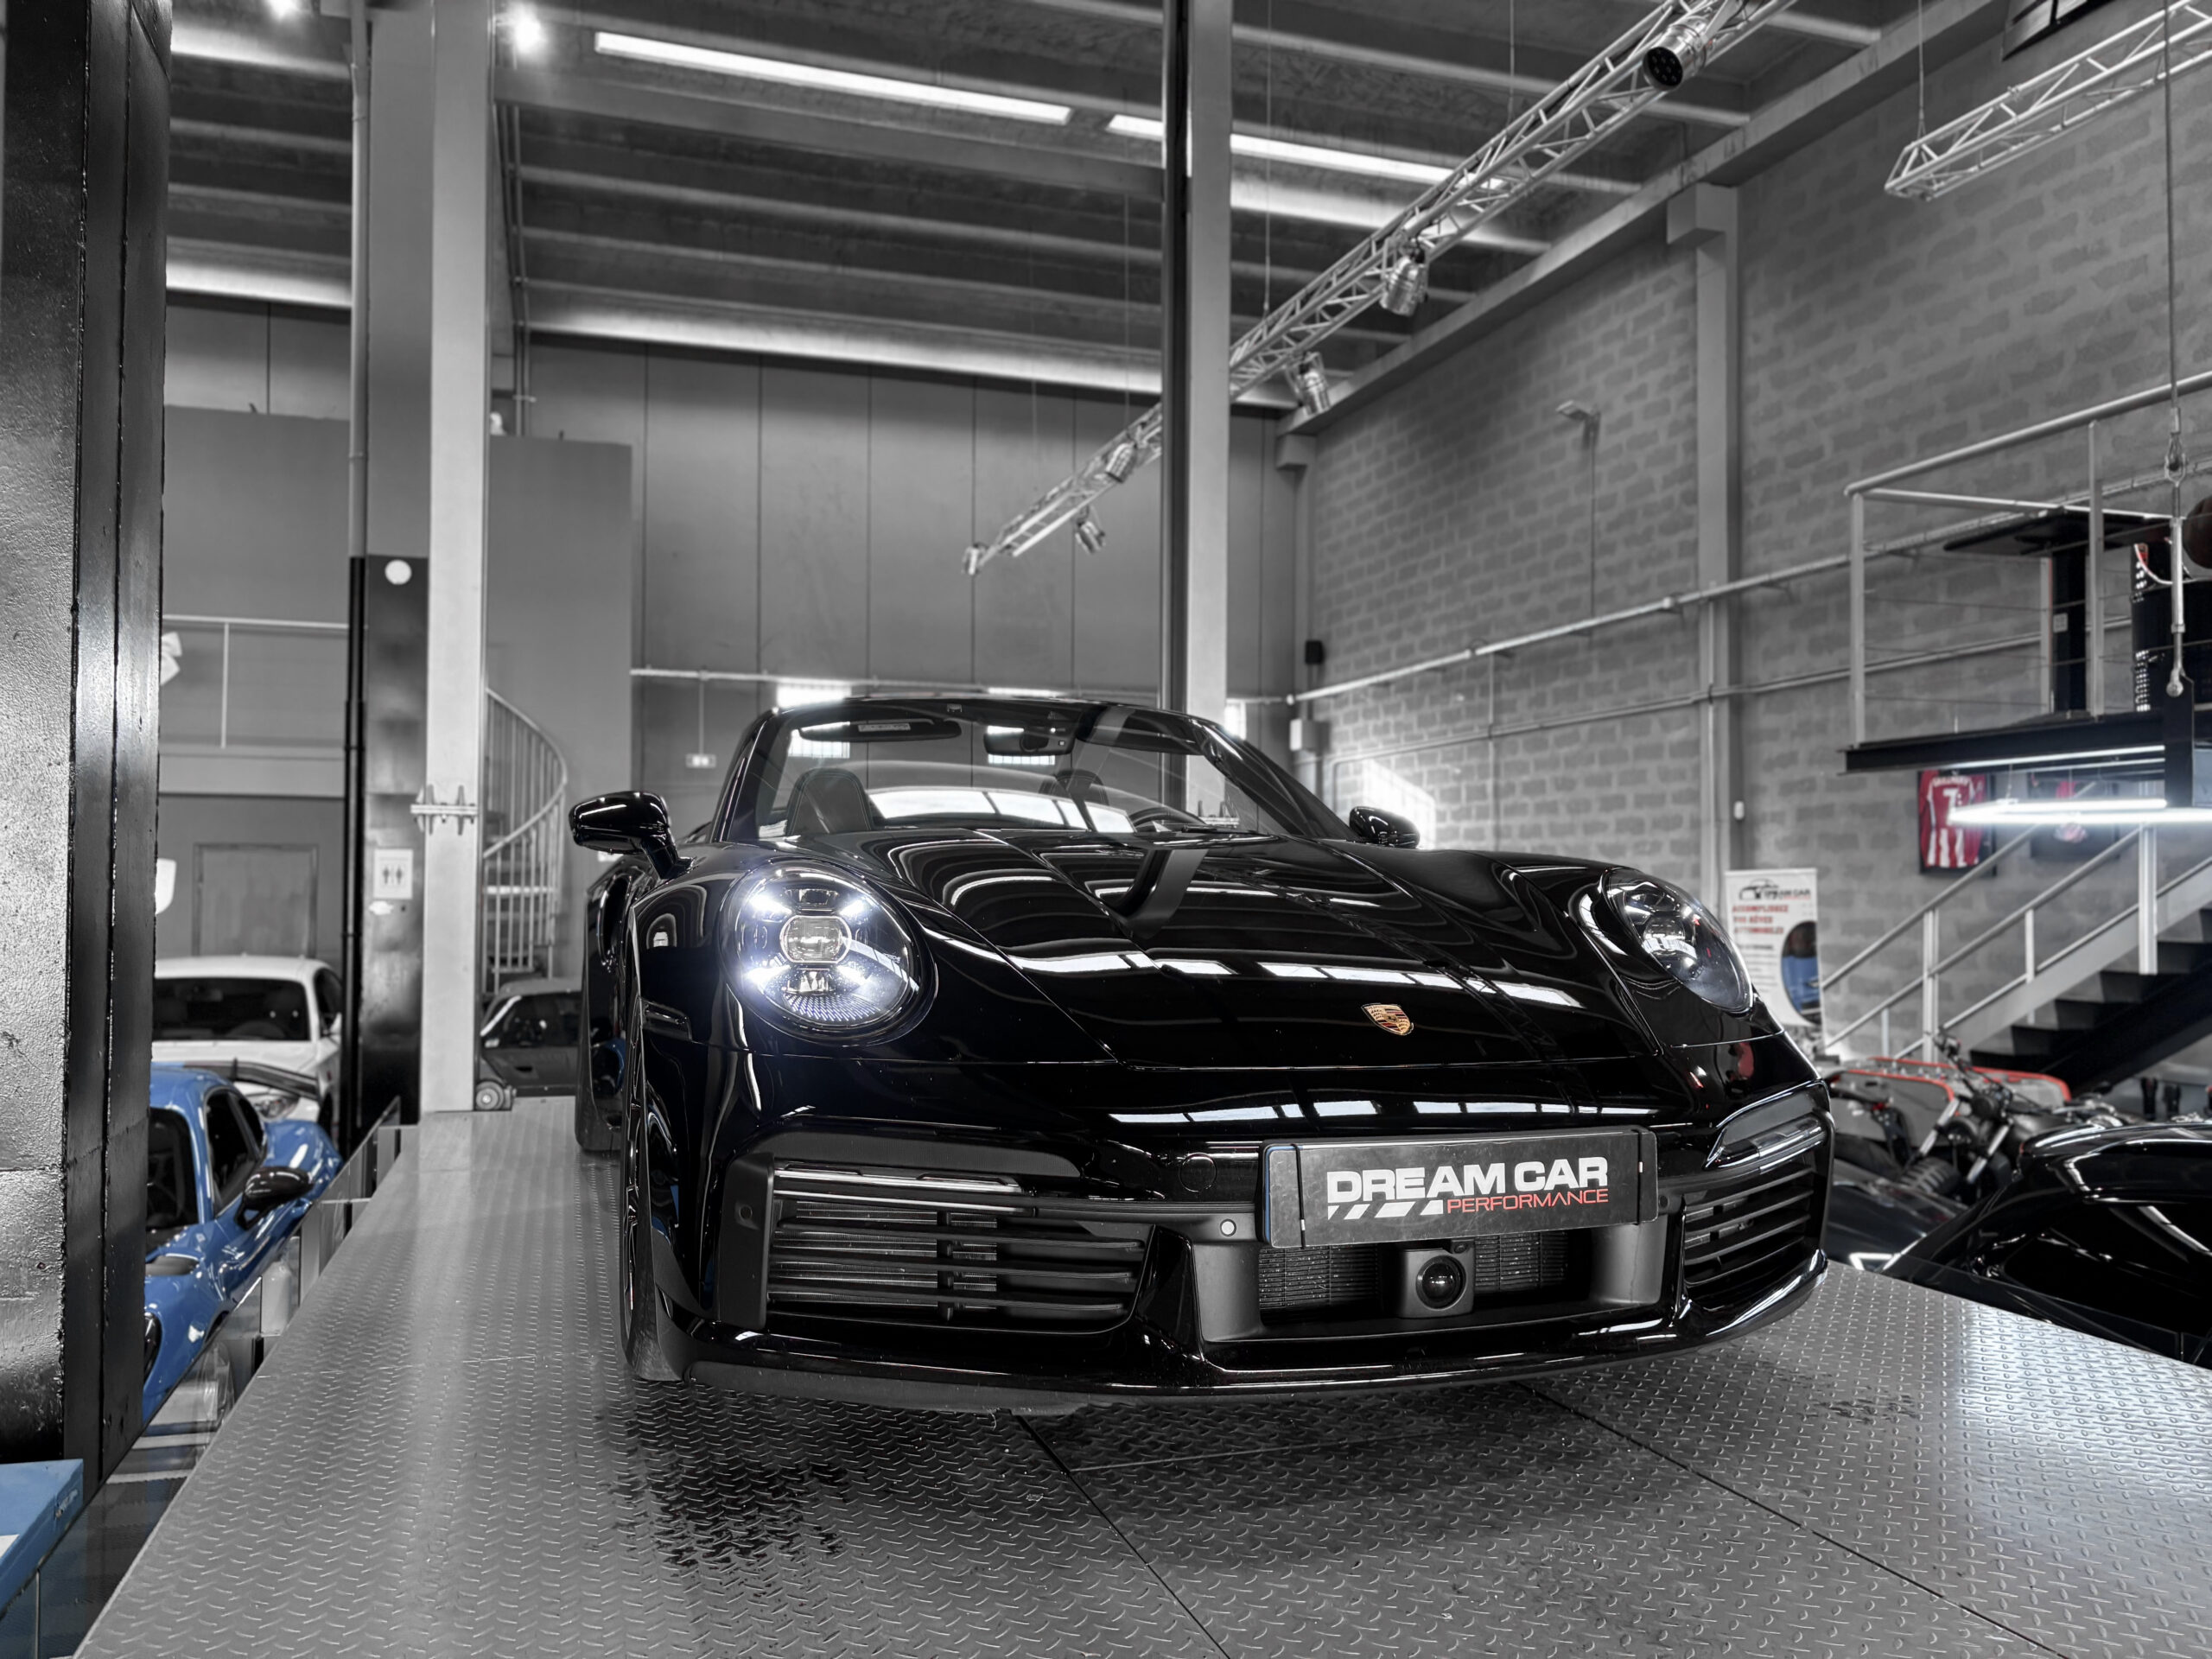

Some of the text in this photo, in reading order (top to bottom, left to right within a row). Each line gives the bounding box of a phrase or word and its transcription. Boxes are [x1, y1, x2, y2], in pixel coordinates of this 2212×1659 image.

[1326, 1156, 1608, 1204] DREAM CAR
[1446, 1188, 1609, 1214] PERFORMANCE
